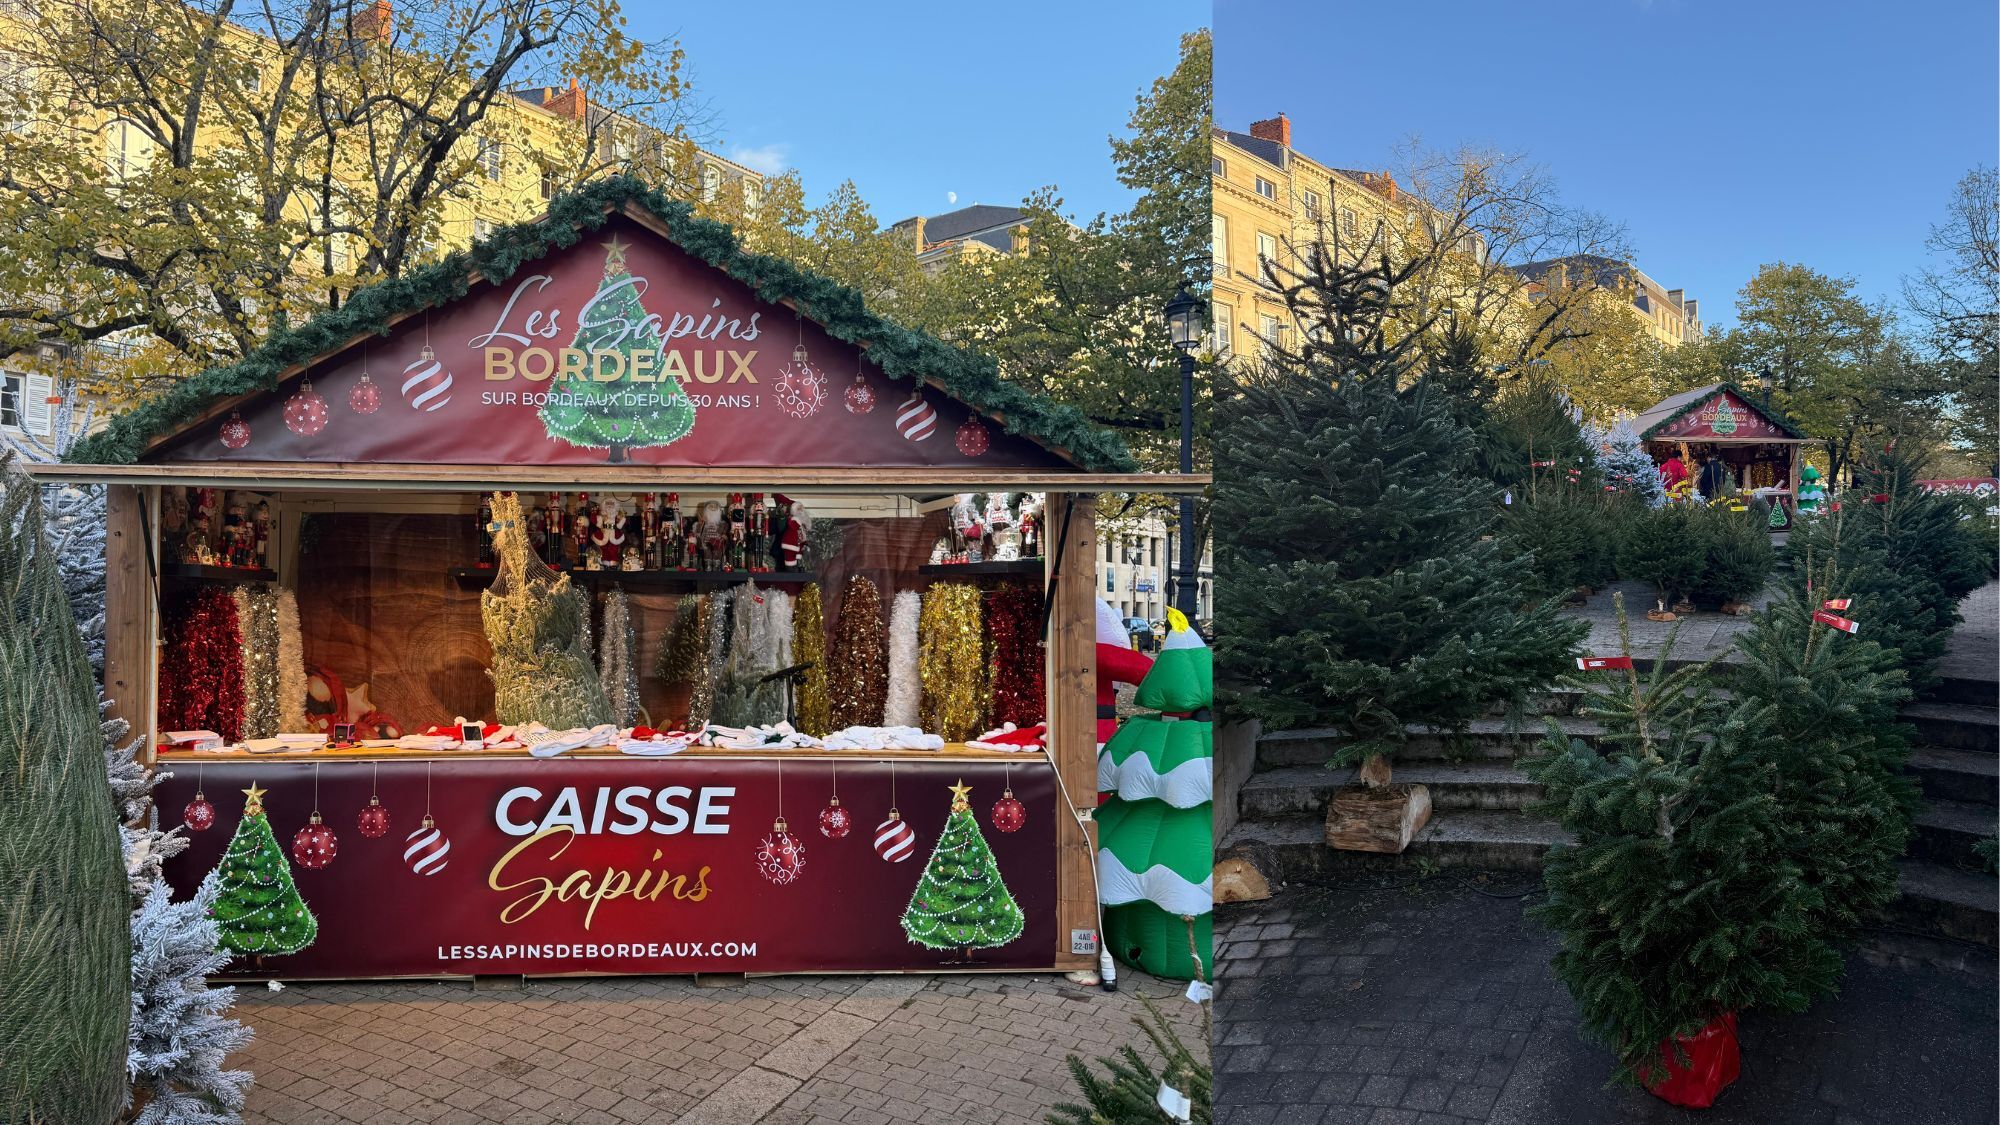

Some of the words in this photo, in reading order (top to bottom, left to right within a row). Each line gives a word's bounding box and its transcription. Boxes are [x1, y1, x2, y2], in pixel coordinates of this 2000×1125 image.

[467, 274, 562, 348] Les
[577, 275, 762, 362] Sapins
[484, 346, 759, 384] BORDEAUX
[481, 391, 517, 405] SUR
[522, 392, 620, 407] BORDEAUX
[624, 393, 688, 407] DEPUIS
[691, 394, 712, 408] 30
[715, 395, 751, 408] ANS
[755, 395, 760, 408] !
[1702, 413, 1747, 421] BORDEAUX
[494, 785, 736, 836] CAISSE
[487, 824, 713, 931] Sapins
[437, 942, 758, 960] LESSAPINSDEBORDEAUX.COM
